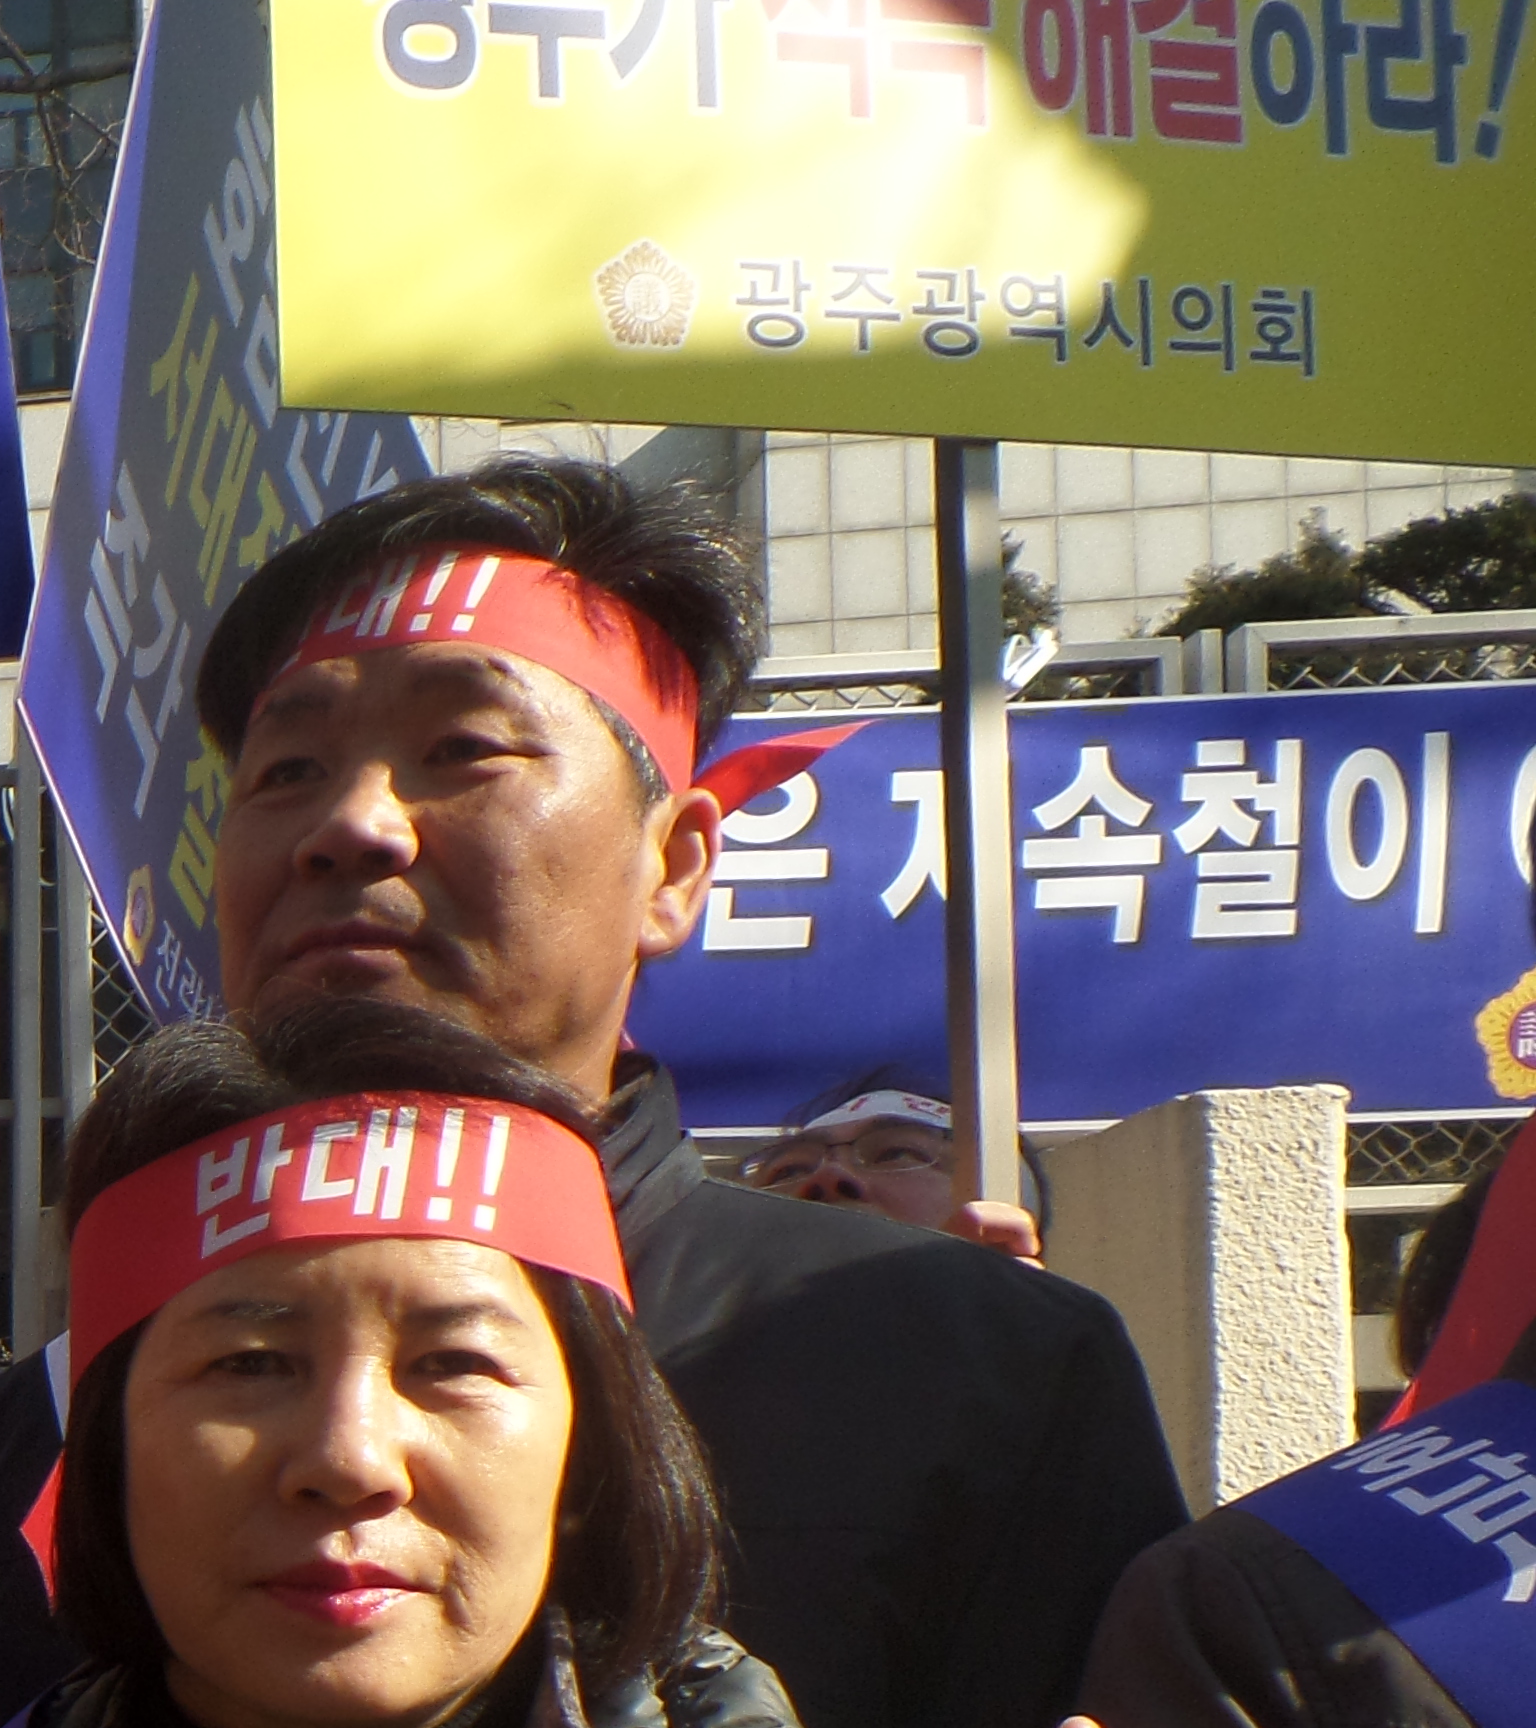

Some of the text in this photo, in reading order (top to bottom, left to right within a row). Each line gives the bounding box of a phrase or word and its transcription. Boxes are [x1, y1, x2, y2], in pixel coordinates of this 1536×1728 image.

[734, 260, 1316, 376] 광주광역시의회
[85, 460, 190, 819] 즉각
[195, 1106, 511, 1258] 반대!!
